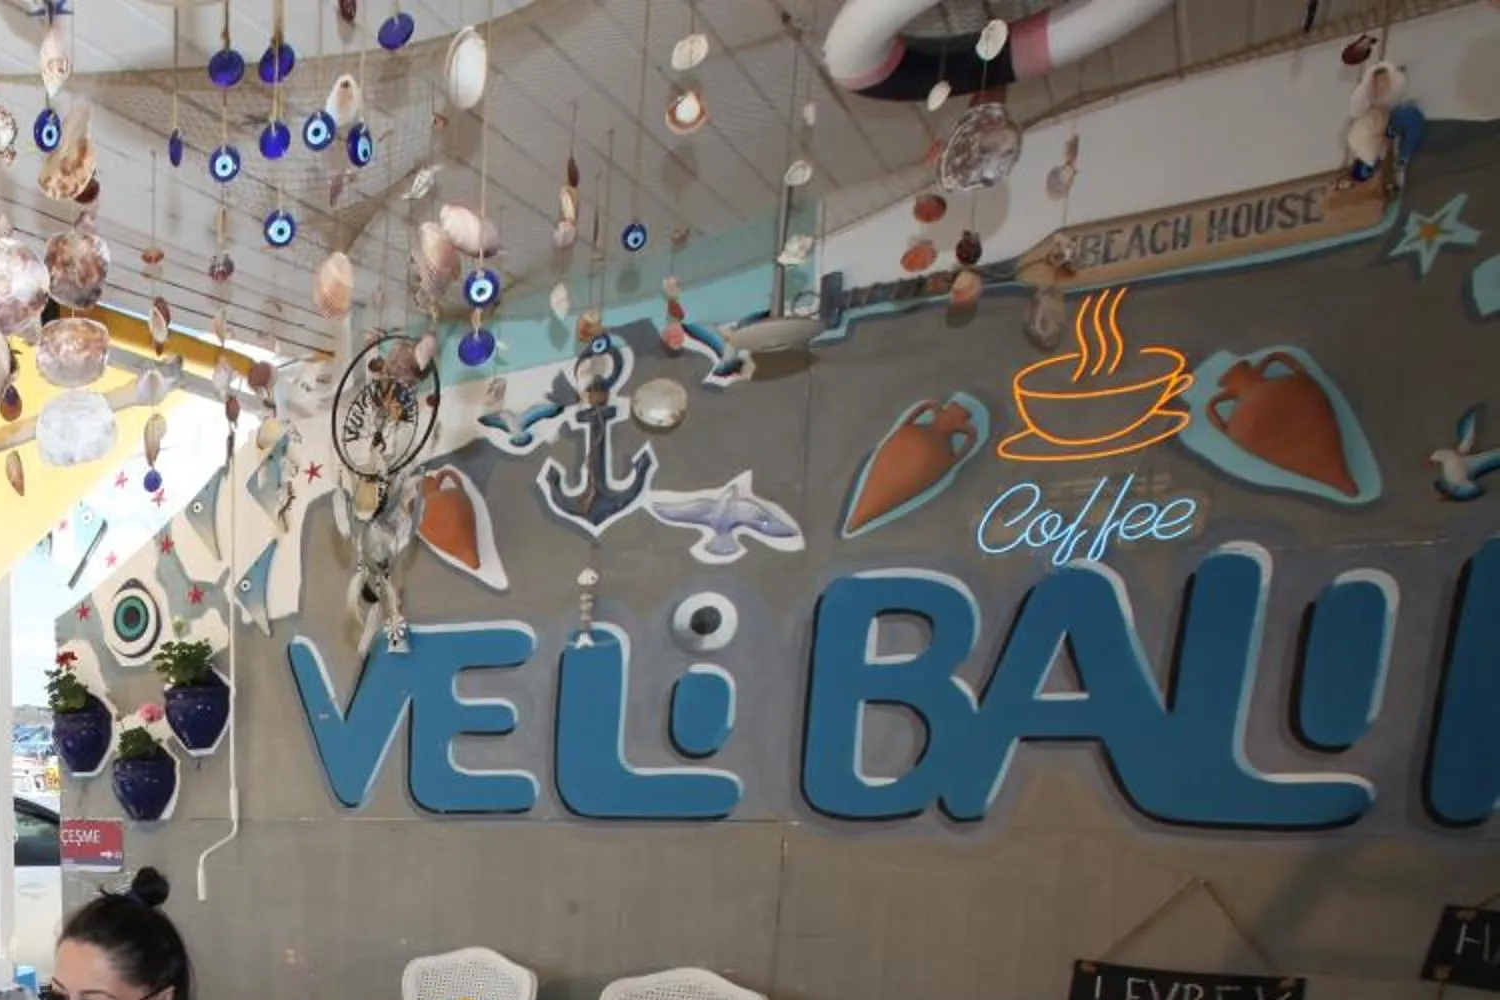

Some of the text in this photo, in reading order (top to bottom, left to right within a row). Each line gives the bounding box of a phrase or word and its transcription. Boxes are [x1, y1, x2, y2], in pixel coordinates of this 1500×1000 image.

[1073, 187, 1327, 268] BEACH HOUSE
[977, 473, 1196, 566] Coffee
[288, 590, 744, 820] VELİ
[60, 829, 101, 847] ÇEŞME
